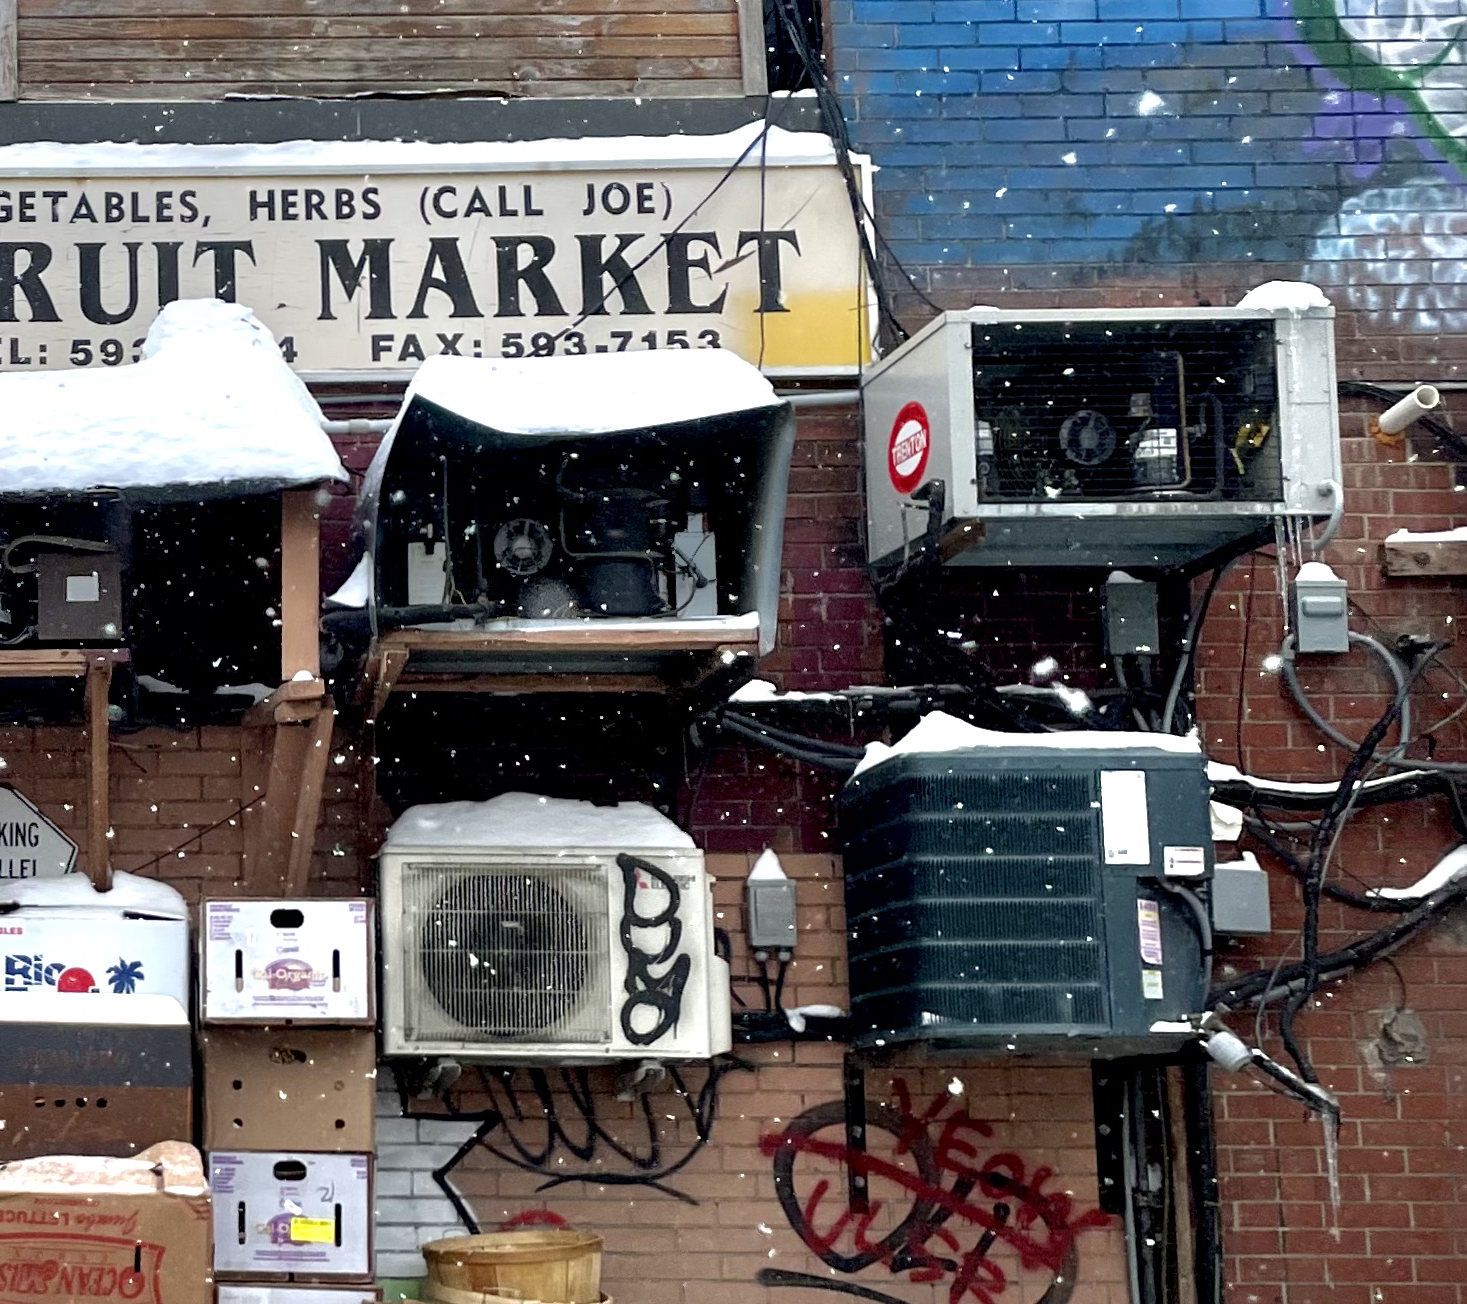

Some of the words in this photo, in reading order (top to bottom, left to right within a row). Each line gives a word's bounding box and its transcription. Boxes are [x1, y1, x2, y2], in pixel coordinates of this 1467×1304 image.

[248, 187, 382, 223] HERBS
[419, 184, 545, 225] (CALL
[582, 182, 673, 221] JOE)
[314, 229, 802, 320] MARKET
[371, 332, 482, 362] FAX:
[501, 329, 721, 357] 593-7153
[891, 427, 927, 467] TRENTON
